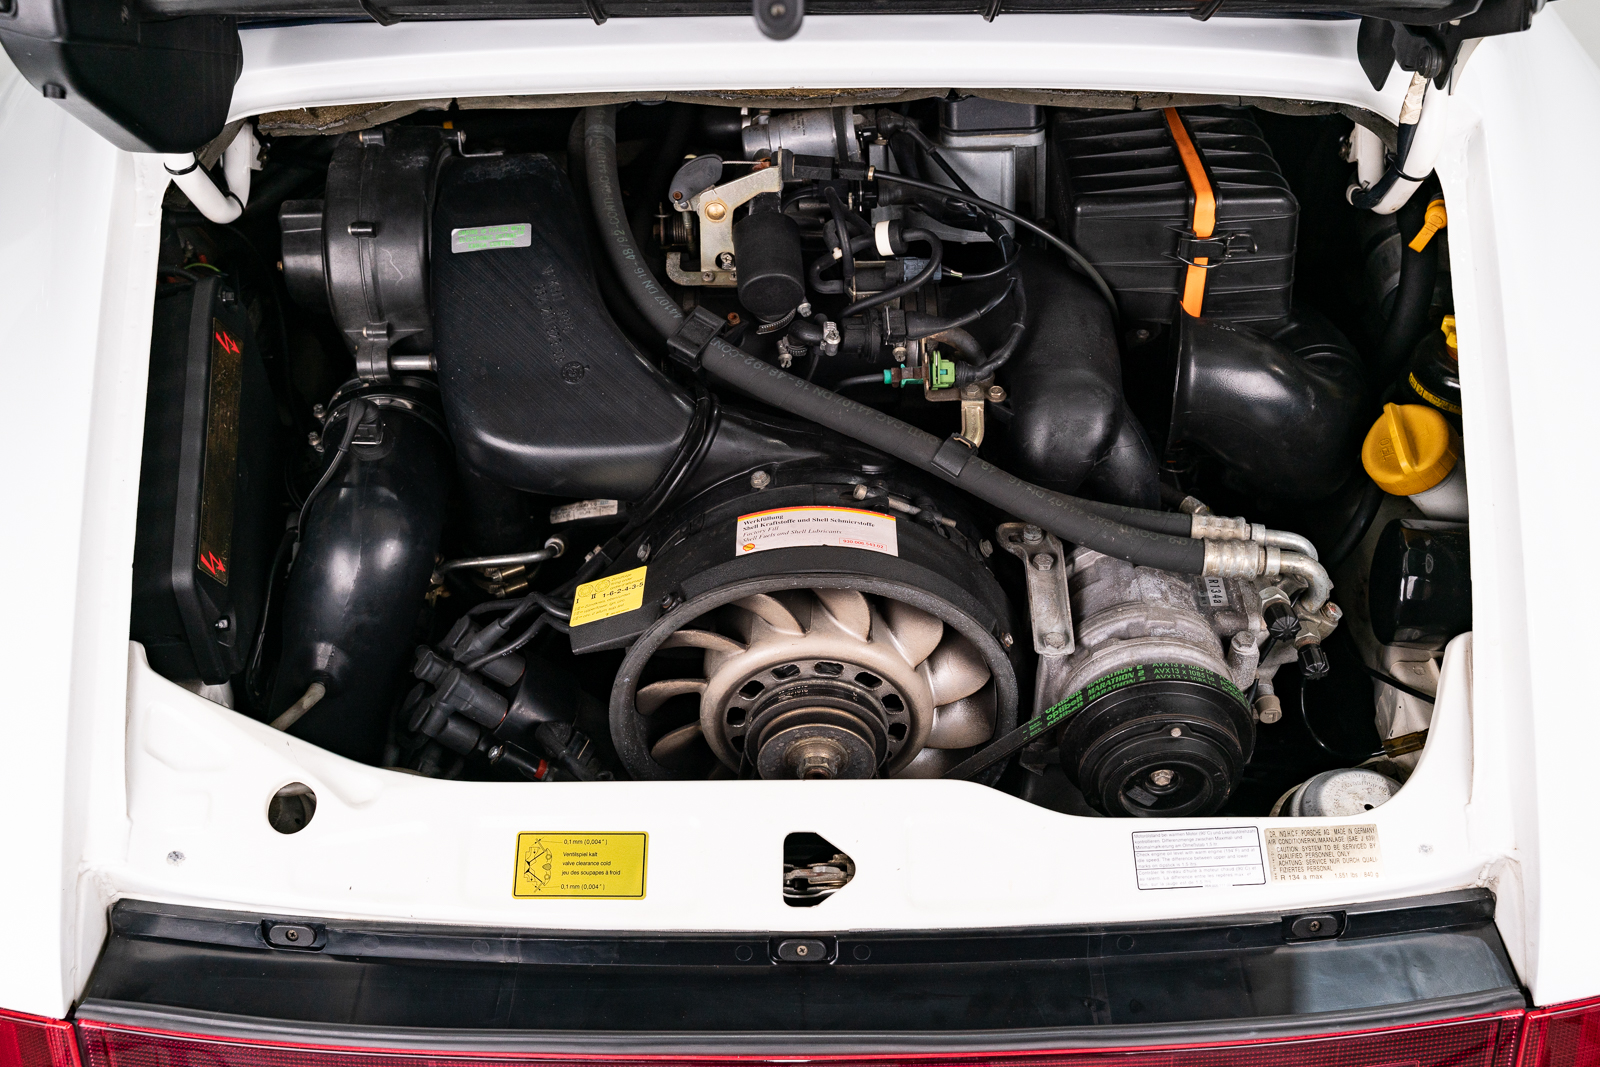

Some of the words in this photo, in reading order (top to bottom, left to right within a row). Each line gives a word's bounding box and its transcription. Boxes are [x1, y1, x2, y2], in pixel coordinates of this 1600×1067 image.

[633, 266, 645, 279] 16
[644, 279, 659, 295] DN
[655, 295, 683, 319] 44107
[743, 514, 784, 525] Werkfüllung
[760, 518, 796, 528] Kraftstoffe
[830, 518, 875, 527] Schmierstoffe
[603, 582, 643, 597] 1-6-2-4-3-5
[1209, 580, 1223, 603] R134a
[1046, 694, 1084, 721] optibelt
[1087, 672, 1135, 696] MARATHON
